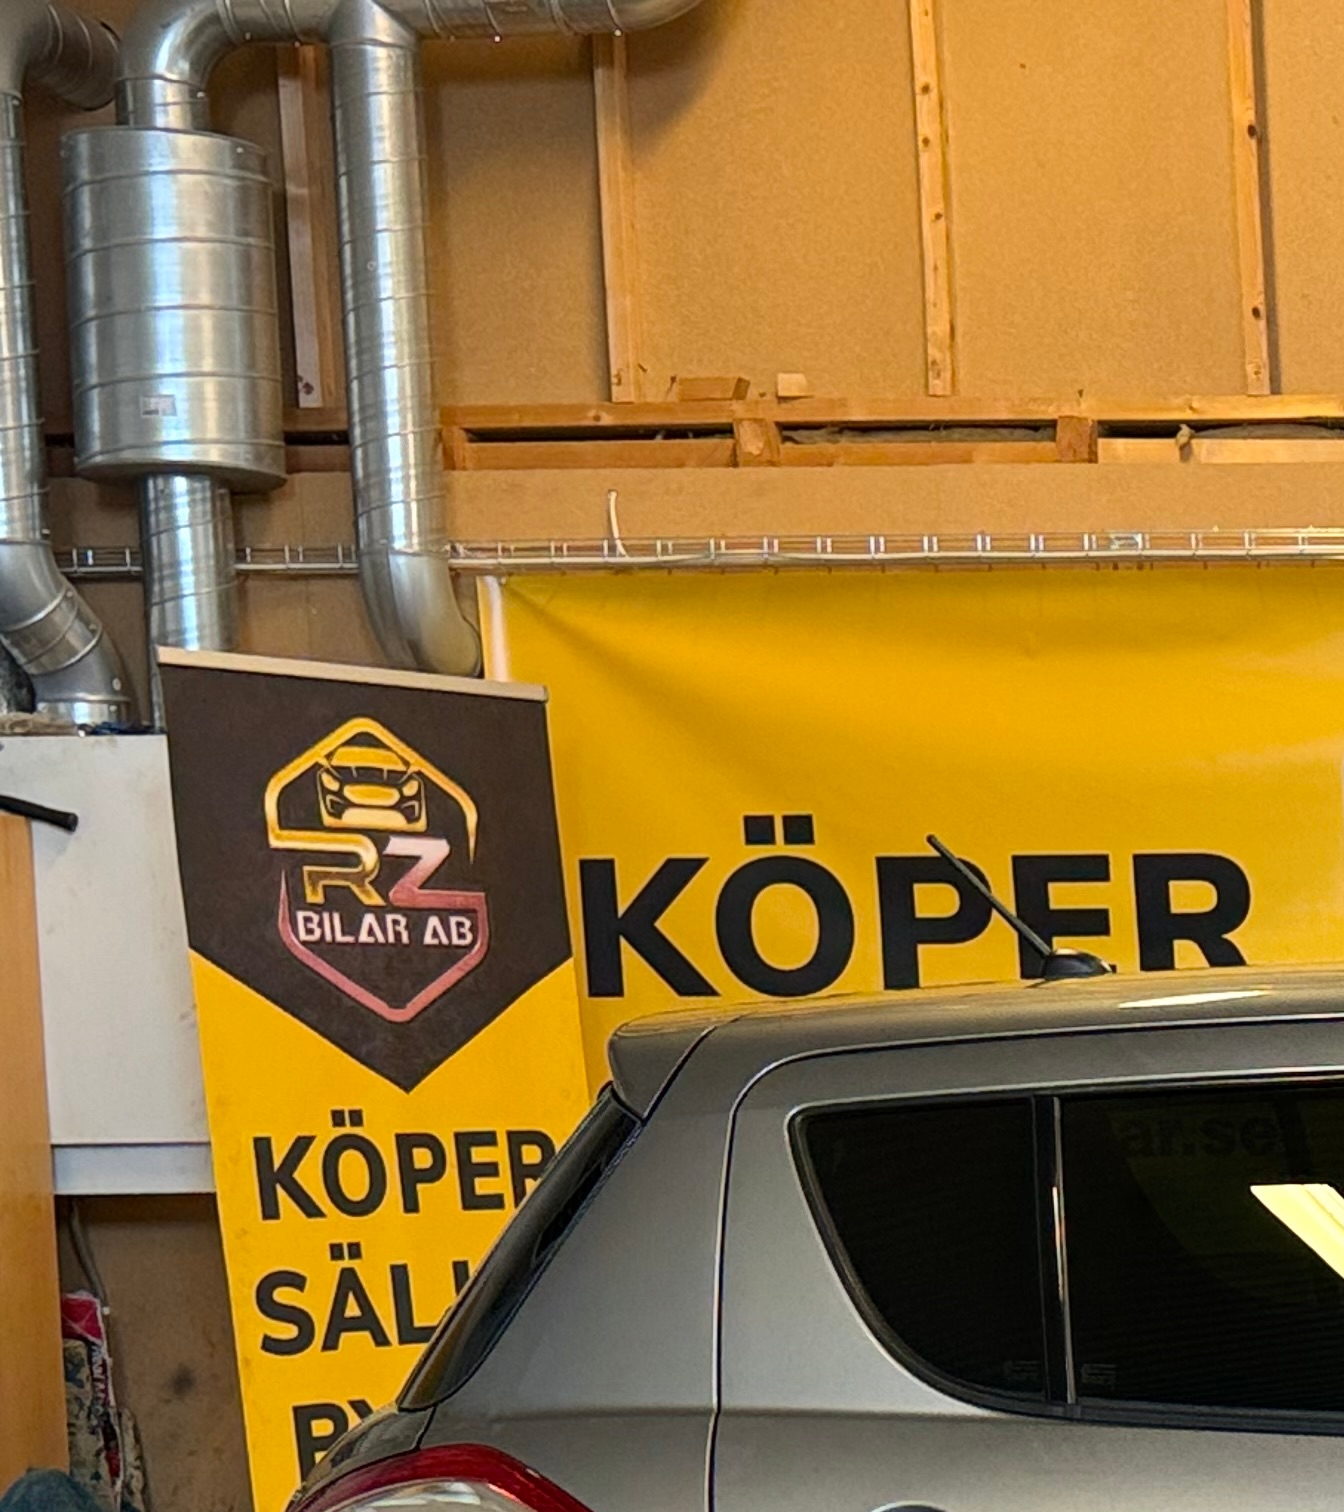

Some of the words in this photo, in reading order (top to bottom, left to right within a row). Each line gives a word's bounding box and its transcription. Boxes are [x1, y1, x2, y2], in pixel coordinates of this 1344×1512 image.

[296, 910, 410, 945] BILAR
[423, 915, 474, 946] AB
[579, 815, 1250, 997] KÖPER
